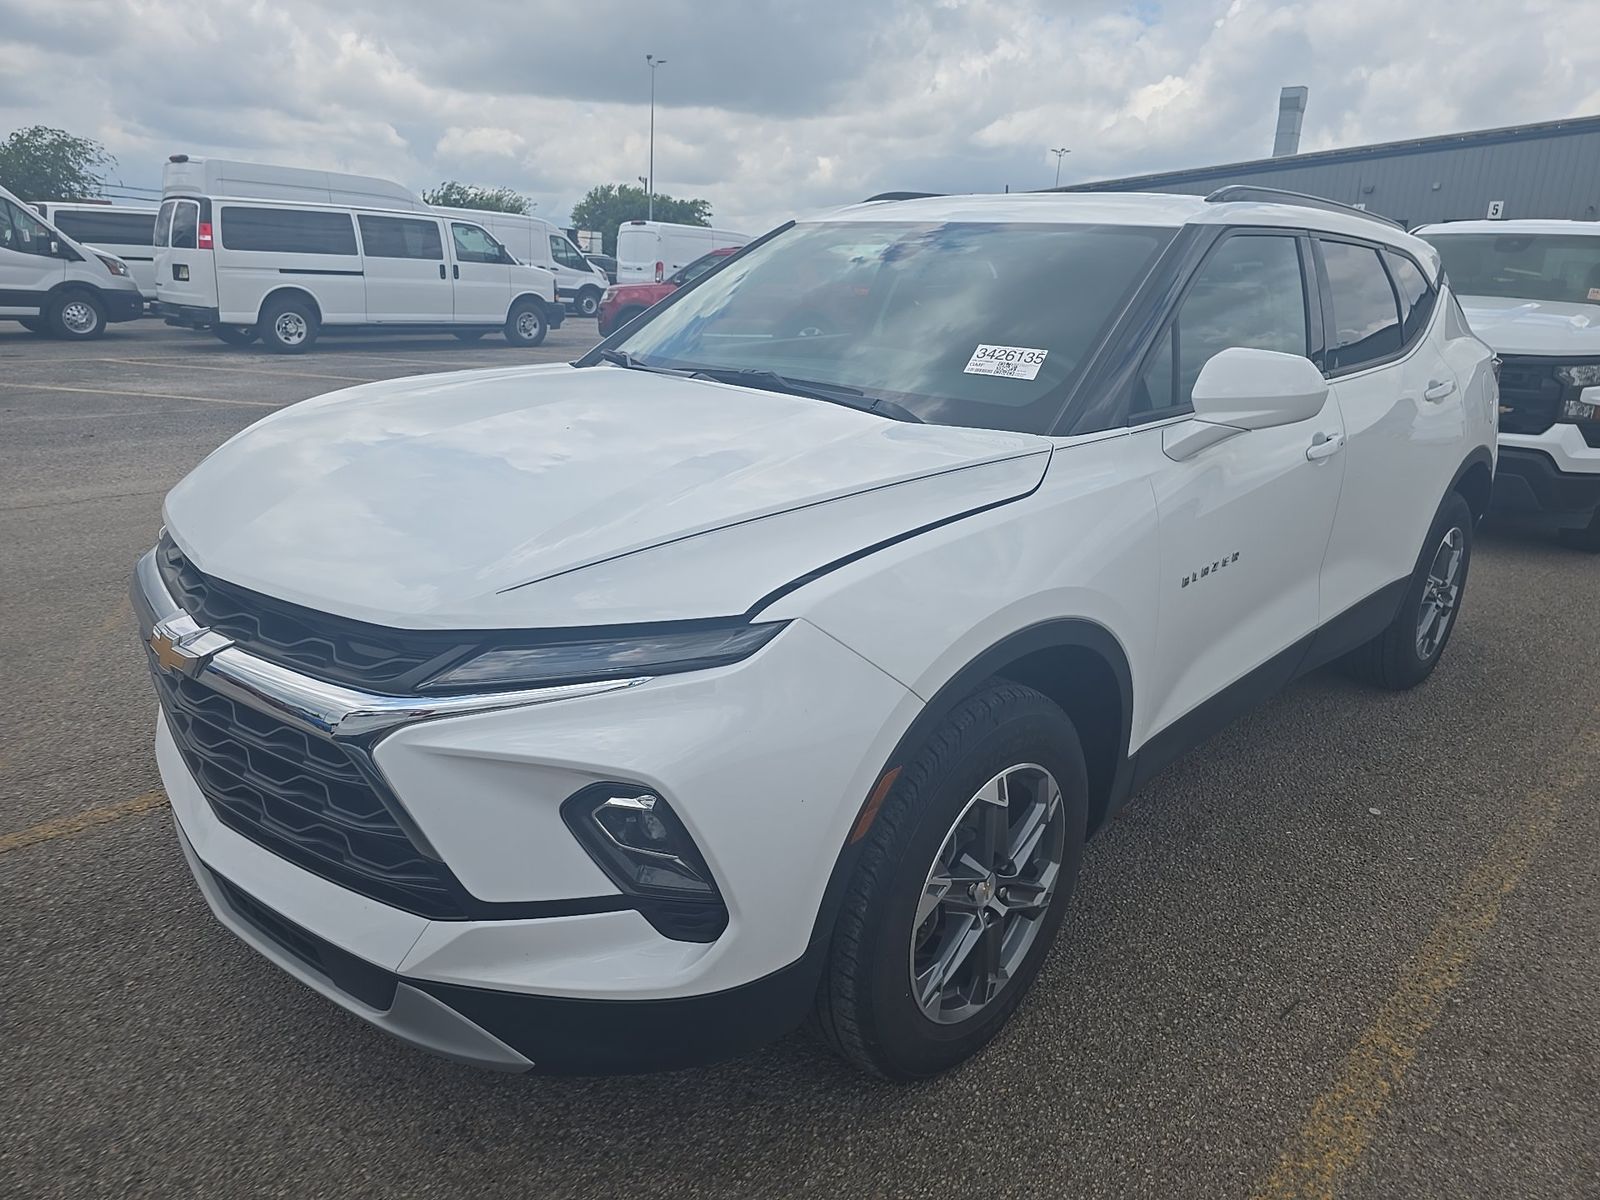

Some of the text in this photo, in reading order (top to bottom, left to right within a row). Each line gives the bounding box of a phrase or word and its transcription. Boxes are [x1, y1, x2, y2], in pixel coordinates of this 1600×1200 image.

[1491, 204, 1499, 216] 5
[976, 347, 1046, 364] 3426135
[1181, 551, 1240, 588] BLAZER
